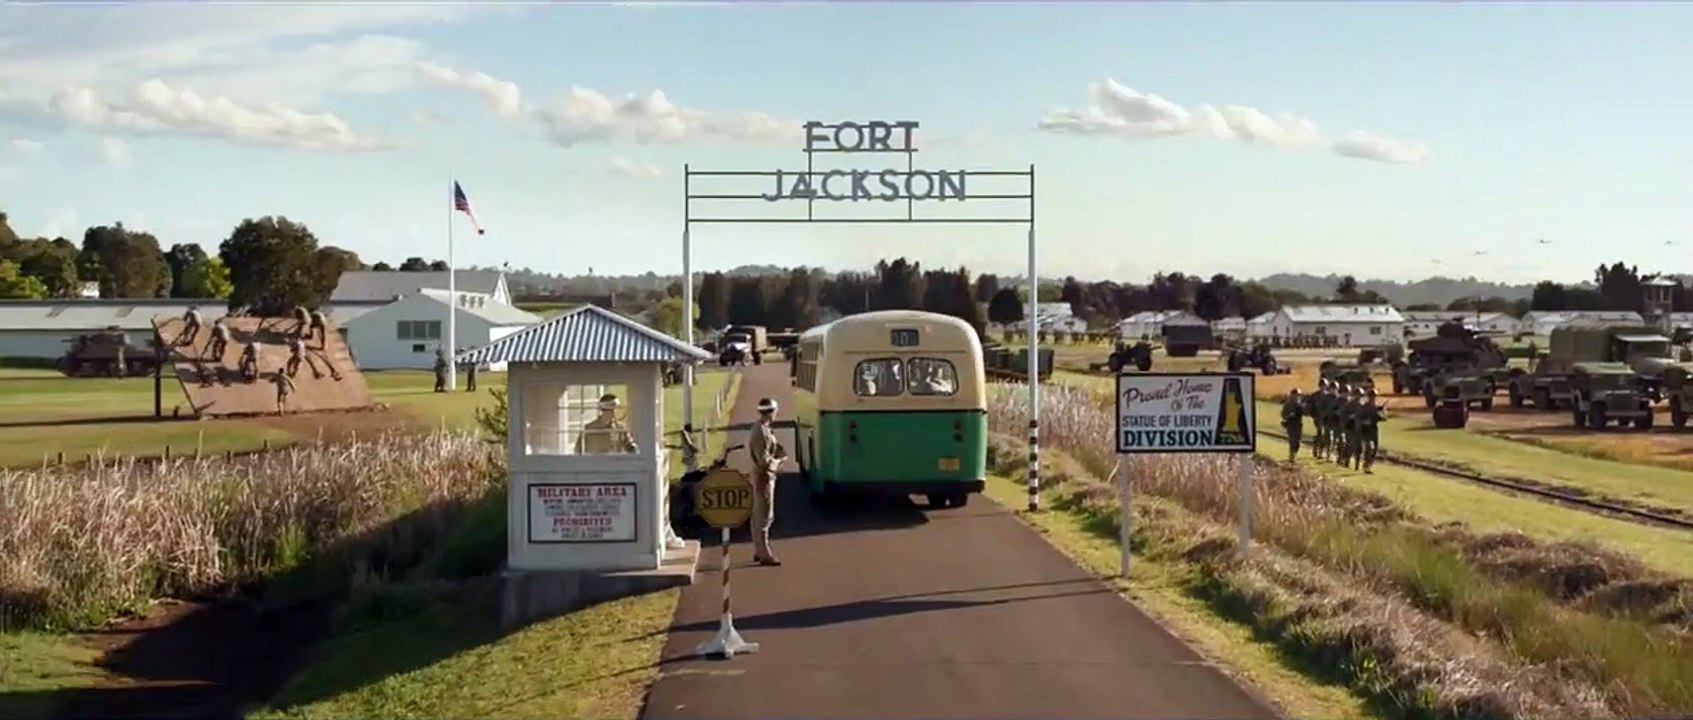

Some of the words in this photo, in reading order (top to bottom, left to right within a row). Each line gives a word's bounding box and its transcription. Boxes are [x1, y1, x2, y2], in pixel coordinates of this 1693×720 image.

[806, 121, 919, 151] FORT
[762, 169, 966, 201] JACKSON
[1123, 384, 1172, 408] Proud
[1173, 379, 1213, 396] Home
[1186, 396, 1205, 410] The
[1122, 415, 1157, 427] STATUE
[1160, 415, 1172, 427] OF
[1174, 415, 1213, 427] LIBERTY
[1123, 430, 1213, 446] DIVISION
[538, 488, 591, 498] MILITARY
[596, 487, 626, 497] AREA
[702, 489, 750, 509] STOP
